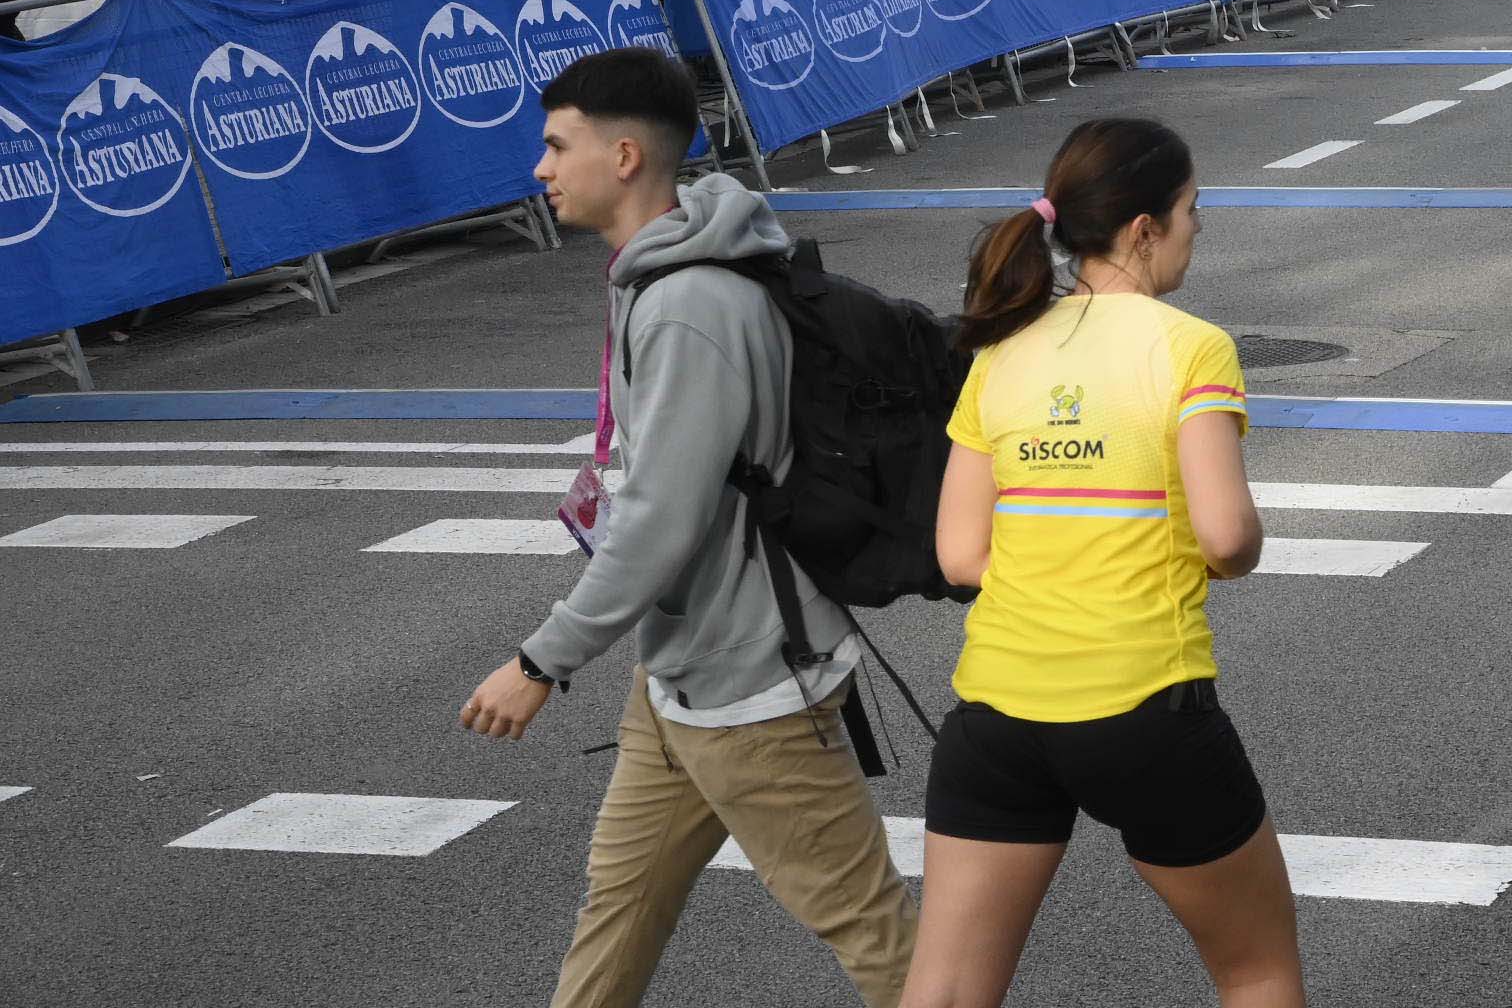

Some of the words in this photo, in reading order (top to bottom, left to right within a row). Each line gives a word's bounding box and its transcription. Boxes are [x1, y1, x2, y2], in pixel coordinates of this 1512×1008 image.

[532, 30, 559, 44] CENTRAL
[438, 46, 471, 61] CENTRAL
[326, 69, 362, 85] CENTRAL
[429, 53, 521, 101] ASTURIANA
[213, 90, 251, 107] CENTRAL
[316, 76, 416, 126] ASTURIANA
[200, 100, 306, 153] ASTURIANA
[0, 160, 53, 201] RIANA
